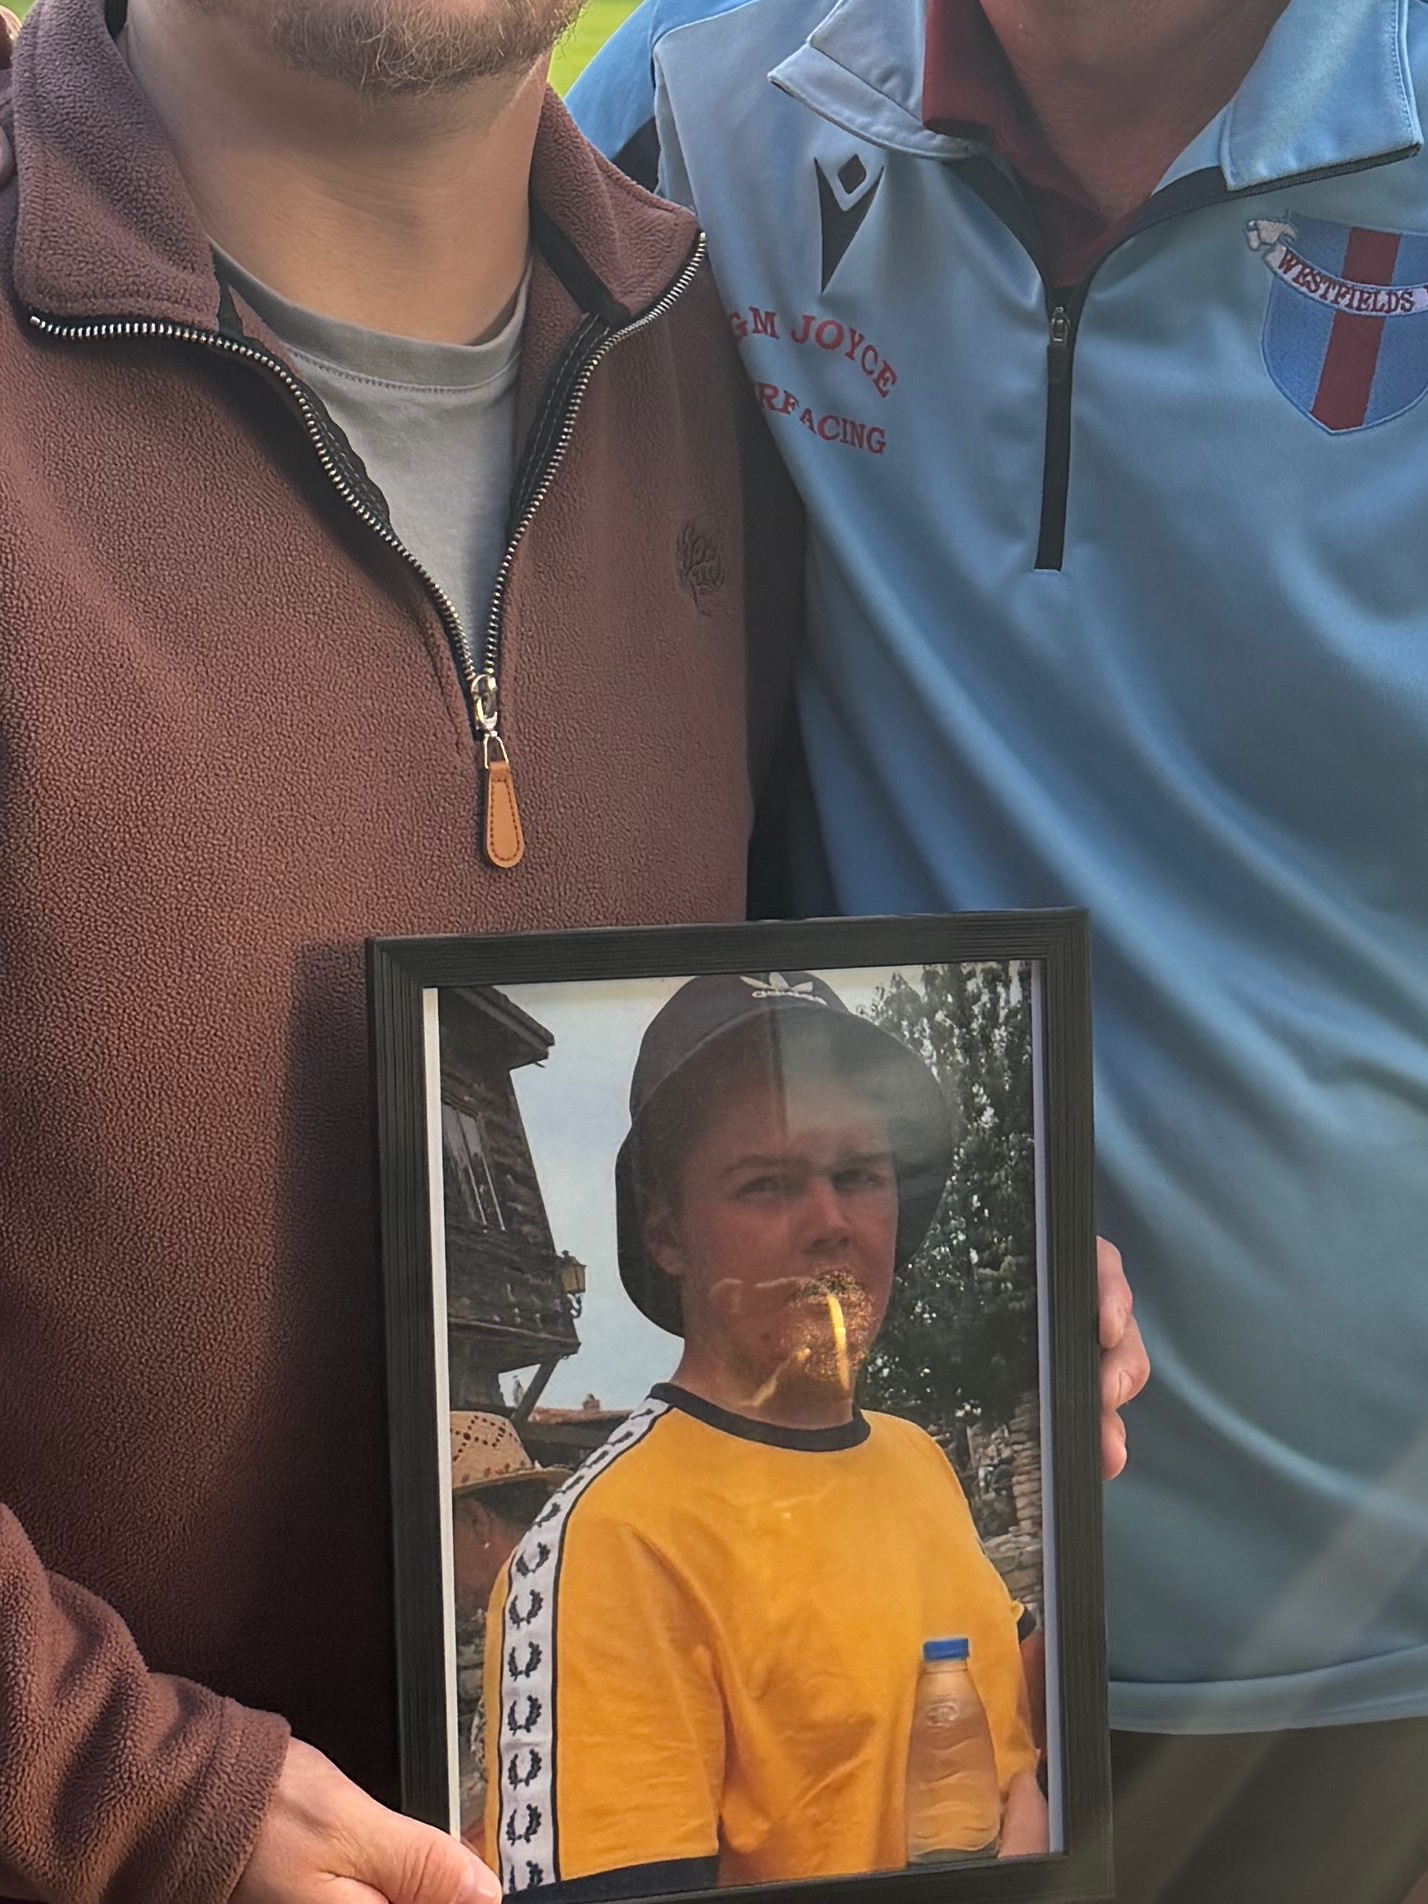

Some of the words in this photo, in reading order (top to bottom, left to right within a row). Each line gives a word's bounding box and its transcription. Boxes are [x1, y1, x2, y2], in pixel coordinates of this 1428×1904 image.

[1277, 249, 1415, 315] WESTFIELDS
[790, 313, 898, 398] JOYCE
[756, 381, 887, 456] RFACING
